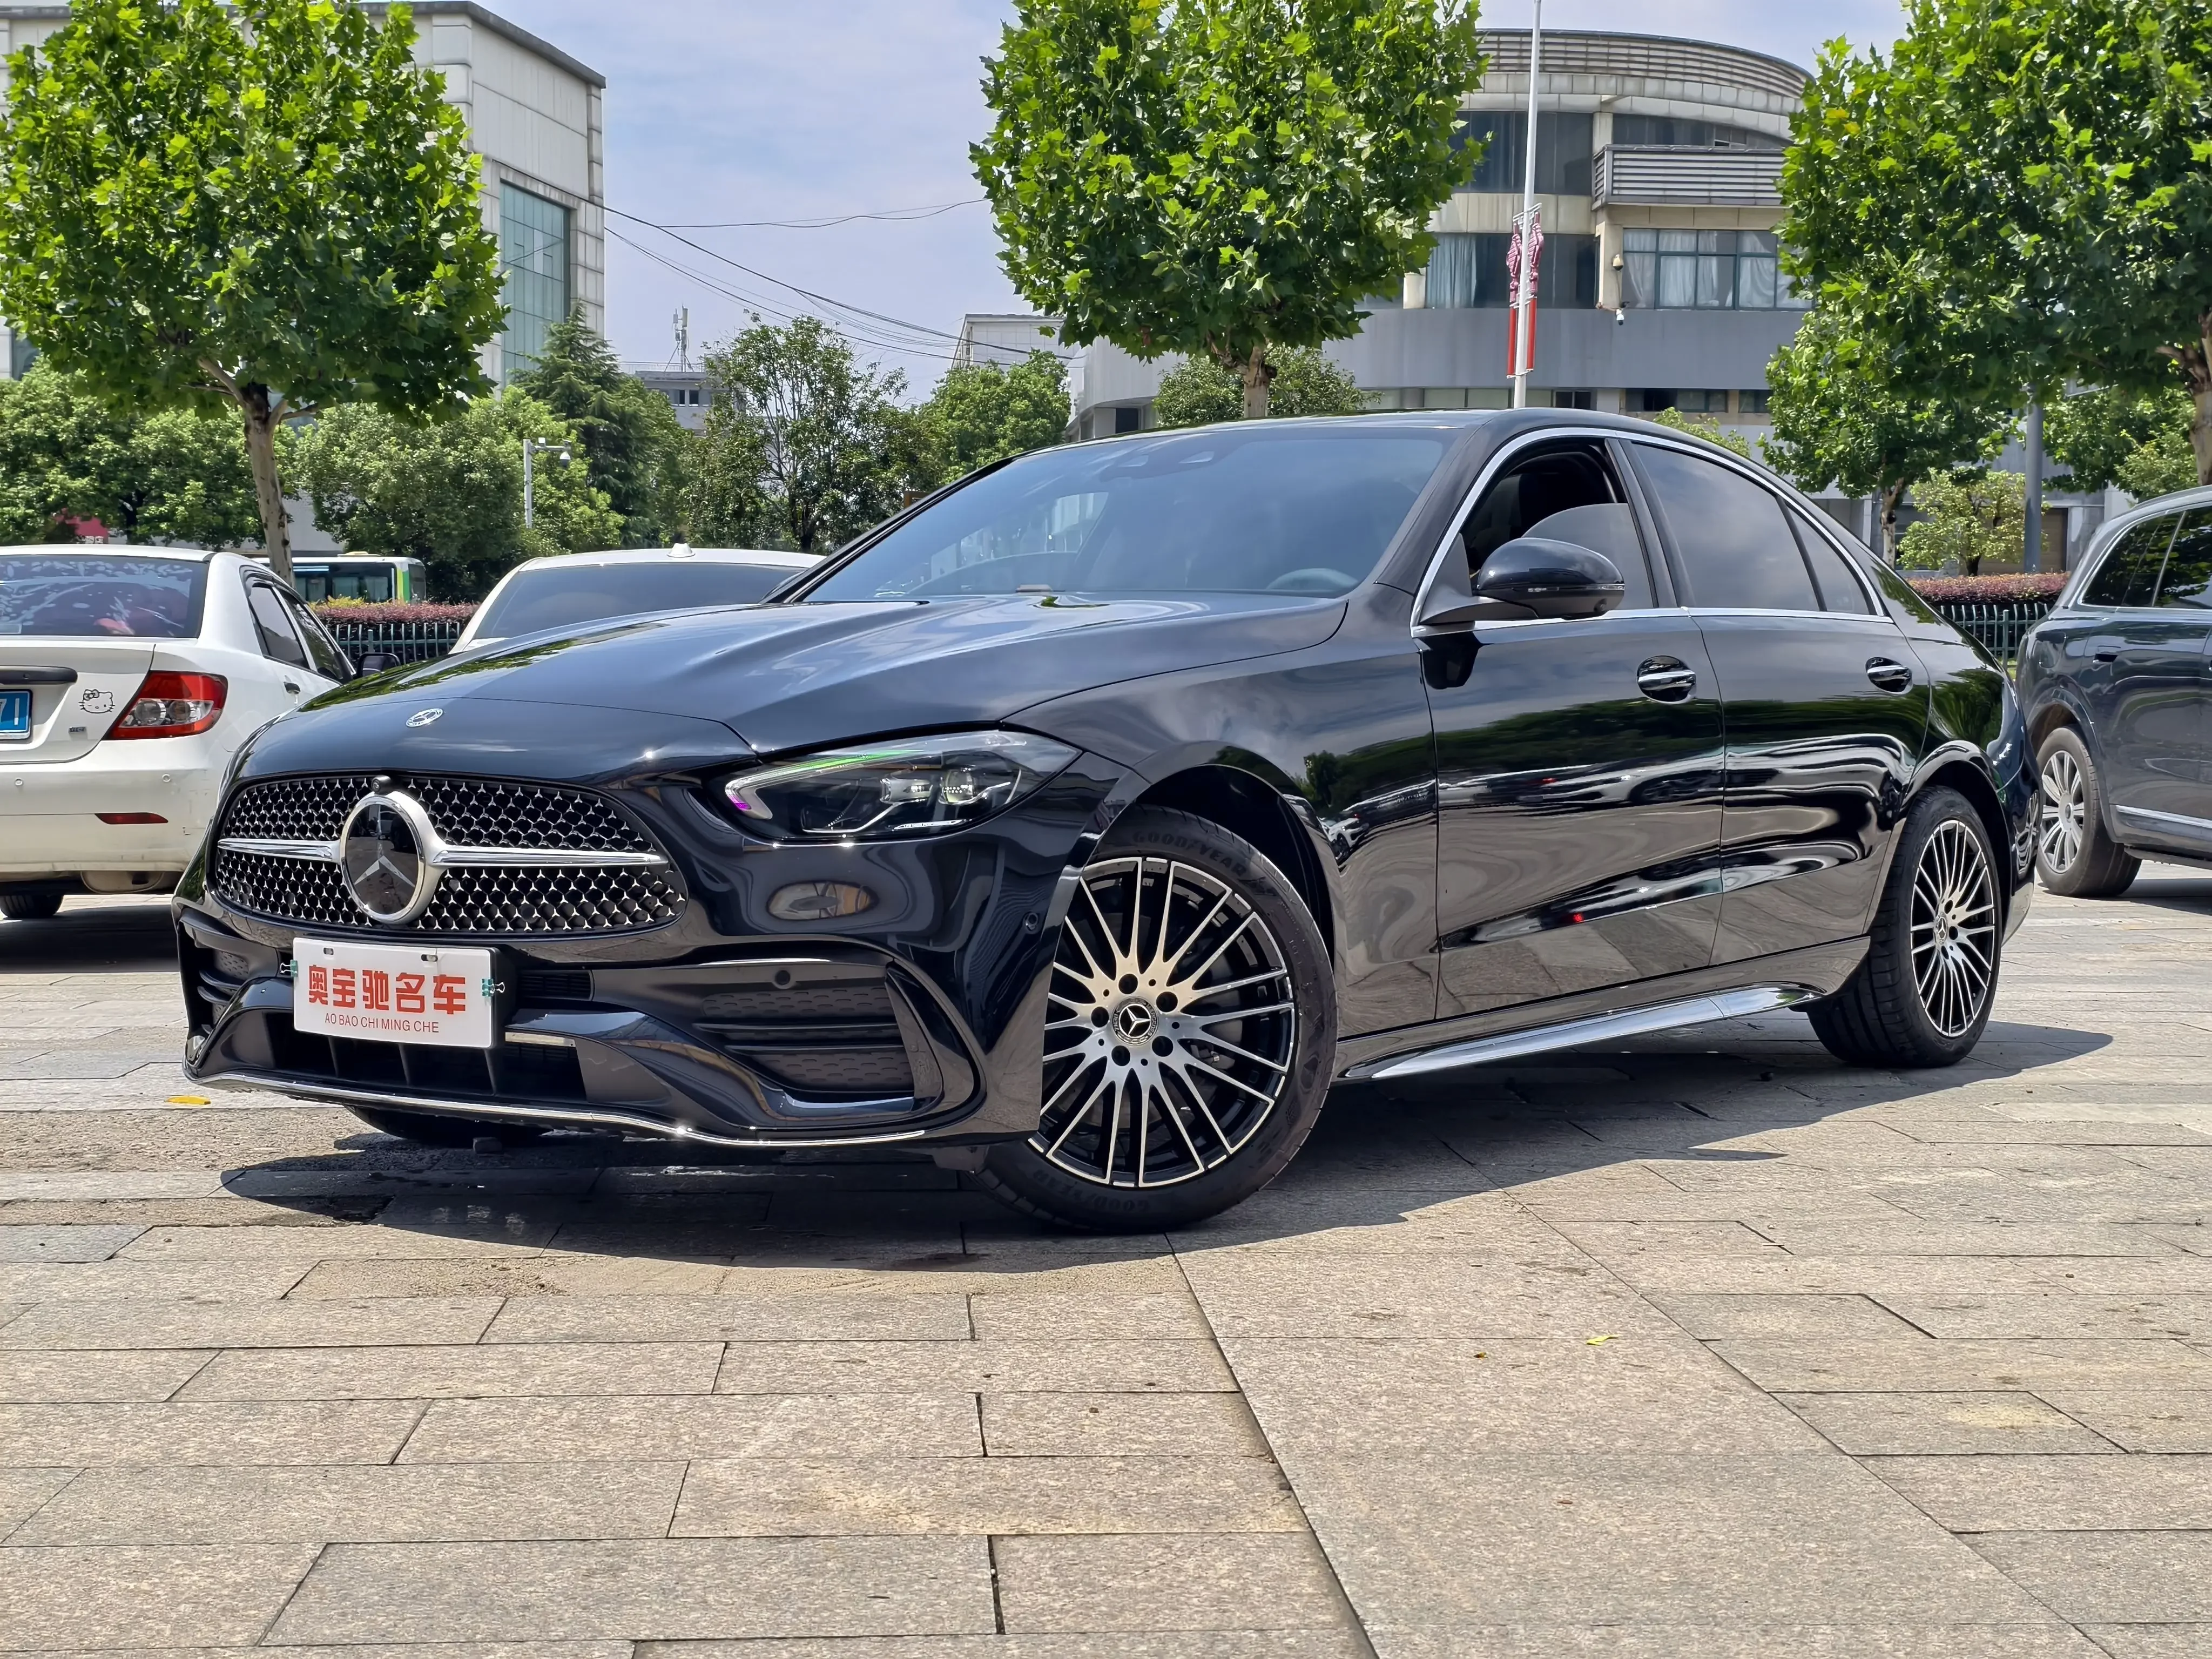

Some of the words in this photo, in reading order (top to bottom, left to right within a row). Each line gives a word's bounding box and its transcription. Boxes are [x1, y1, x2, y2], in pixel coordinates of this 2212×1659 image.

[1132, 831, 1247, 877] GOODYEAR
[309, 965, 466, 1015] 奥宝驰名车
[325, 1013, 337, 1024] AO
[339, 1014, 359, 1027] BAO
[360, 1016, 378, 1028] CHI
[381, 1019, 410, 1031] MING
[413, 1021, 439, 1033] CHE
